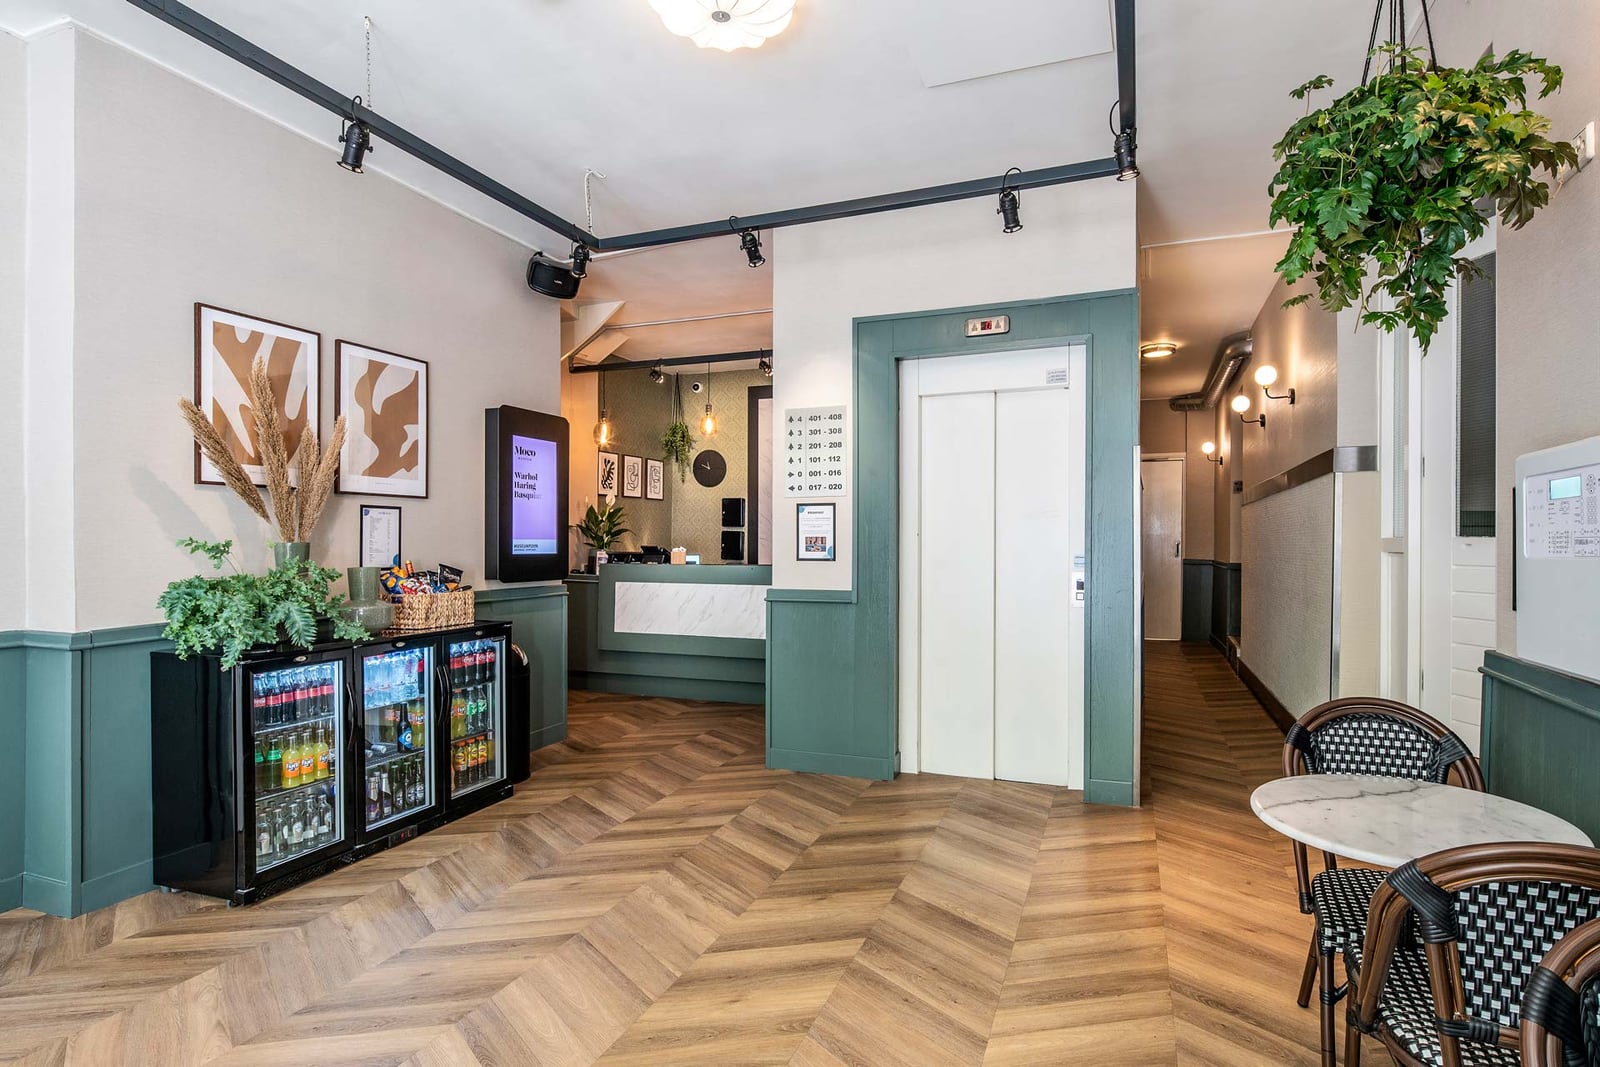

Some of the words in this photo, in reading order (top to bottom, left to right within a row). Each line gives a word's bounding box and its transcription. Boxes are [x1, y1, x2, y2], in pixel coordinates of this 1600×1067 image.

[808, 414, 821, 422] 401
[828, 413, 842, 421] 408
[808, 428, 821, 436] 301
[828, 427, 842, 435] 308
[808, 442, 821, 450] 201
[828, 441, 842, 449] 208
[514, 445, 536, 457] Moco
[828, 455, 841, 463] 112
[514, 471, 538, 481] Warhol
[797, 470, 803, 478] 0
[514, 481, 537, 491] Haring
[514, 490, 541, 501] Basqui
